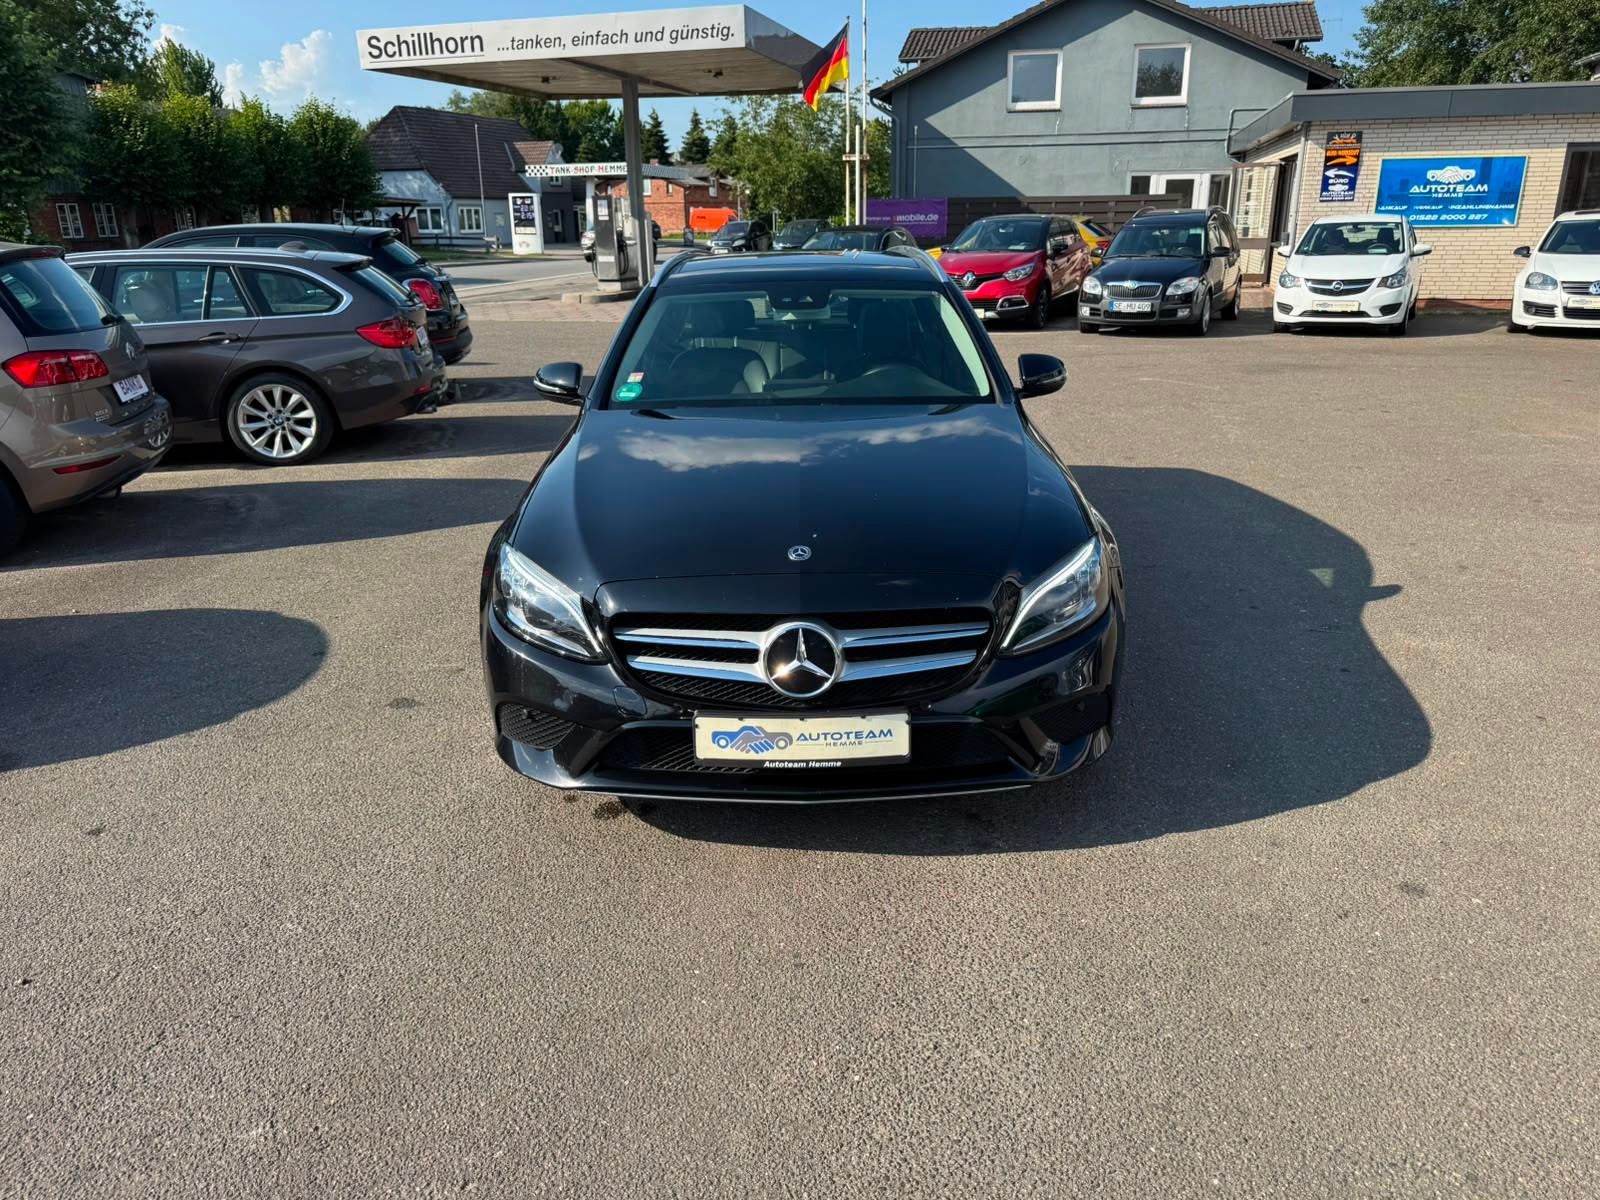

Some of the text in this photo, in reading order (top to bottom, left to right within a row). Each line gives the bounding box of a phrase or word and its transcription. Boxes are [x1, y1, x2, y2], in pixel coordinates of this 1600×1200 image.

[367, 32, 484, 60] Schillhorn
[571, 29, 629, 47] einfach
[634, 26, 665, 43] und
[669, 22, 735, 43] günstig.
[550, 166, 572, 174] TANK
[598, 164, 627, 174] HEMME
[1409, 184, 1488, 193] AUTOTEAM
[896, 213, 939, 222] mobile.de
[1440, 213, 1467, 221] 2000
[1468, 213, 1488, 221] 227
[796, 728, 893, 742] AUTOTEAM
[825, 740, 863, 748] HEMME
[763, 760, 842, 769] Autoteam Hemme
